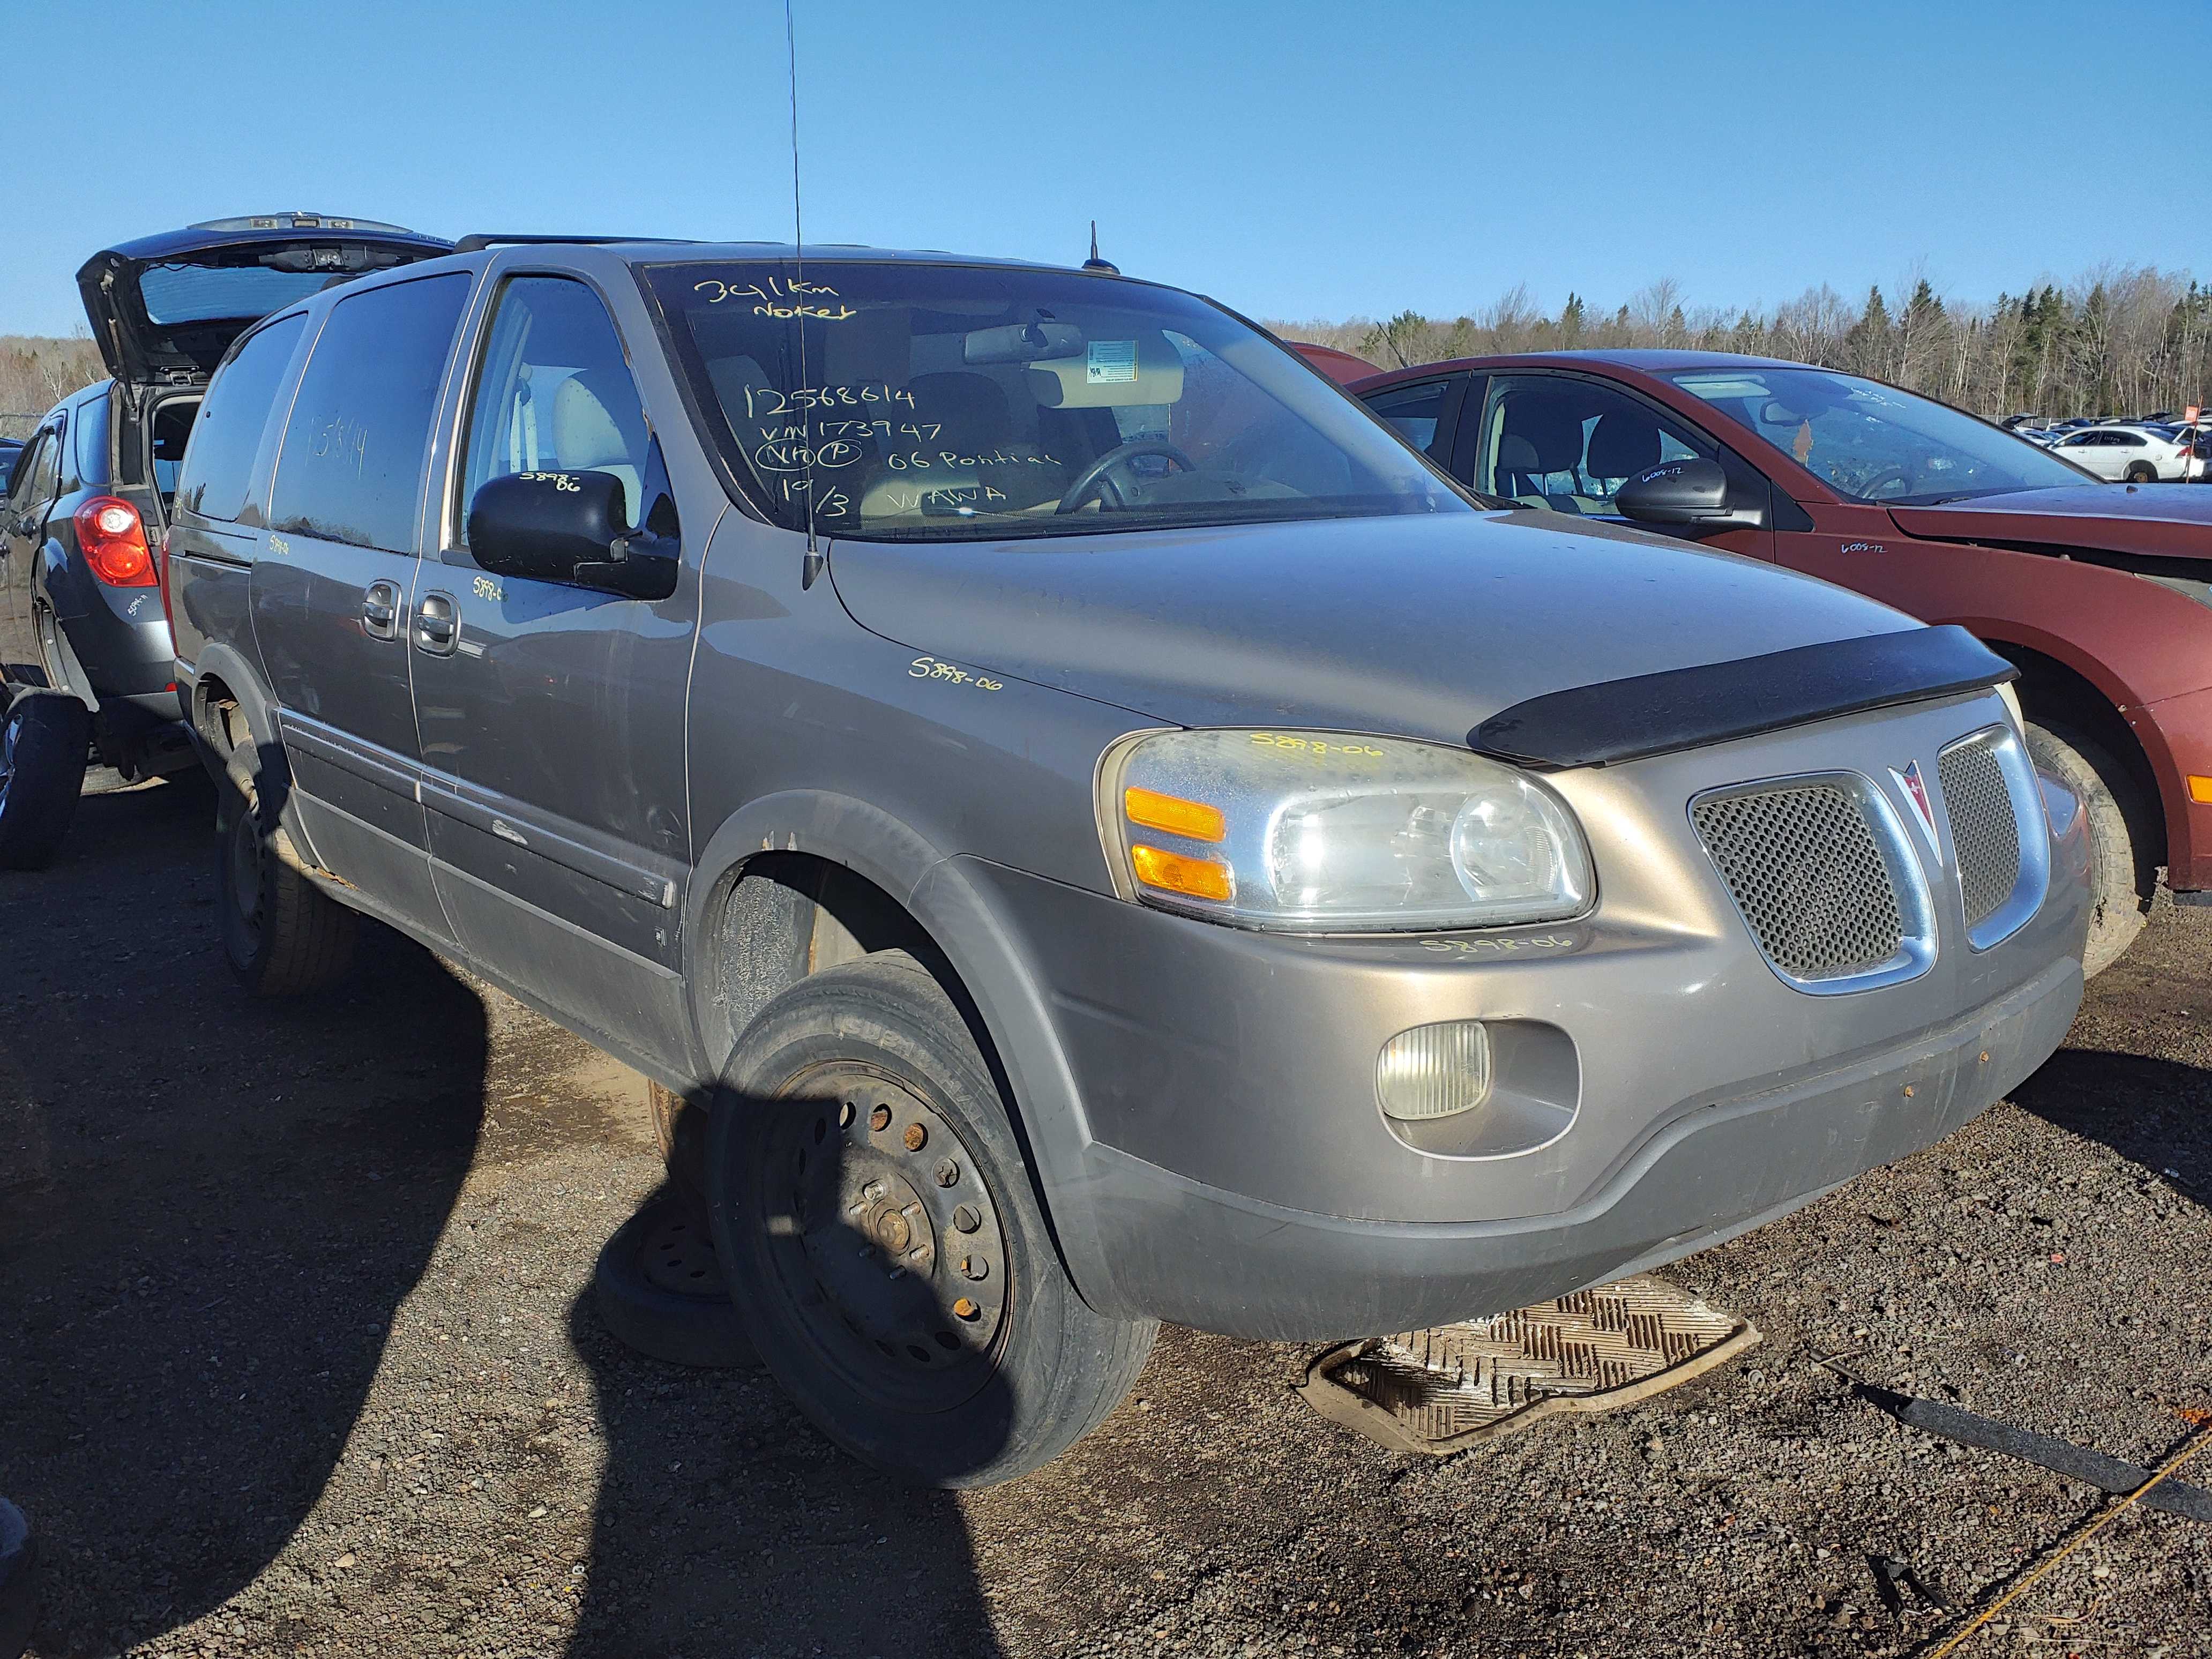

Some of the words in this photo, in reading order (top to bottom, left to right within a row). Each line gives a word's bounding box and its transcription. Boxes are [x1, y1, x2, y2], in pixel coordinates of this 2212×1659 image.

[744, 383, 915, 419] 12568614
[888, 451, 931, 470] 06
[1642, 467, 1685, 482] 6008-12
[887, 485, 1007, 509] WAWA
